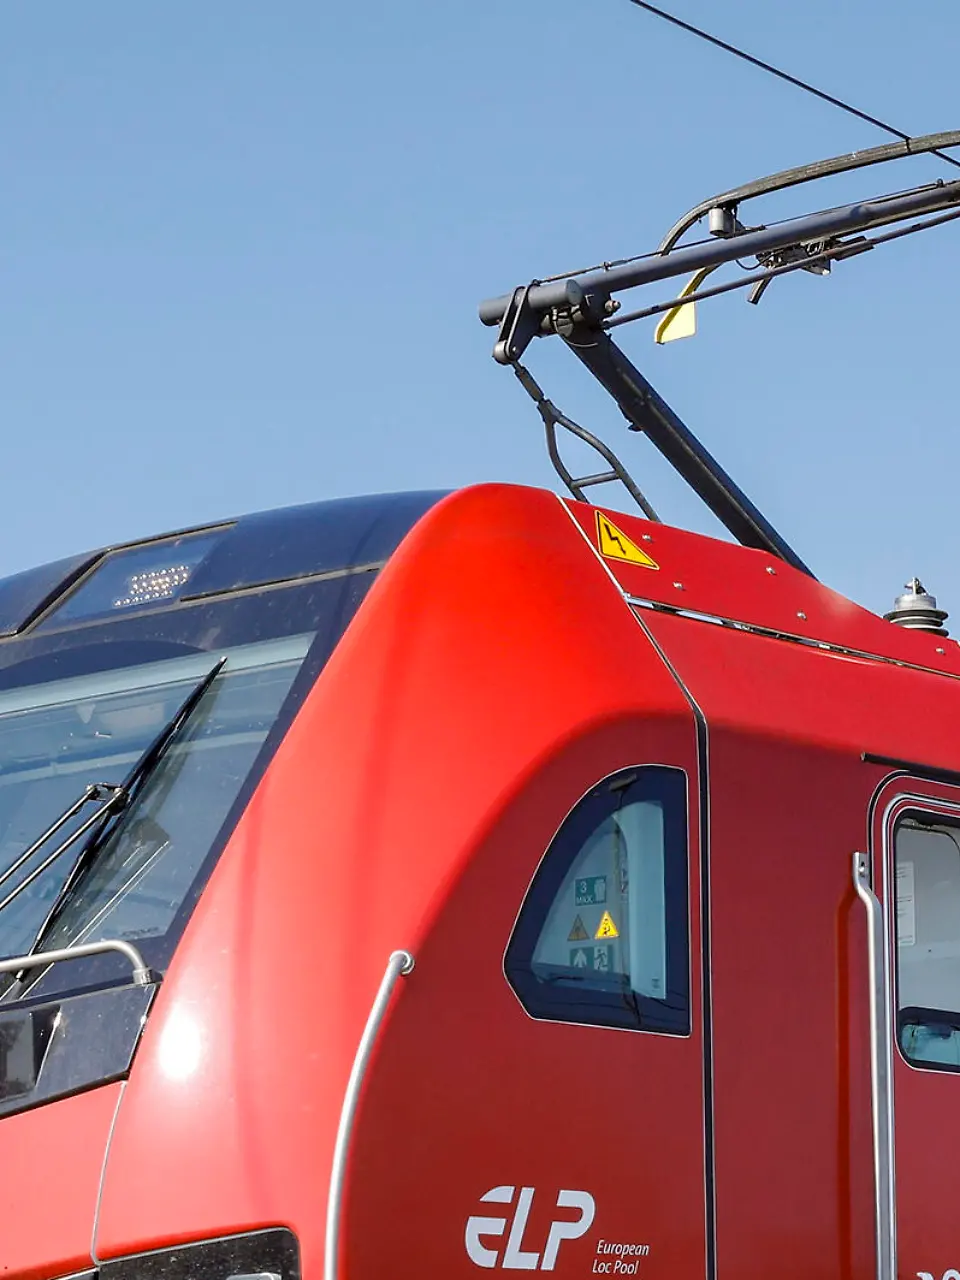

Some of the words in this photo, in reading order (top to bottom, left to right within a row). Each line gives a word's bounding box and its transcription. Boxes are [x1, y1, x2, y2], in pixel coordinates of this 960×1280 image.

[464, 1185, 597, 1271] ELP
[596, 1240, 650, 1259] European
[592, 1259, 611, 1274] Loc
[613, 1260, 639, 1276] Pool
